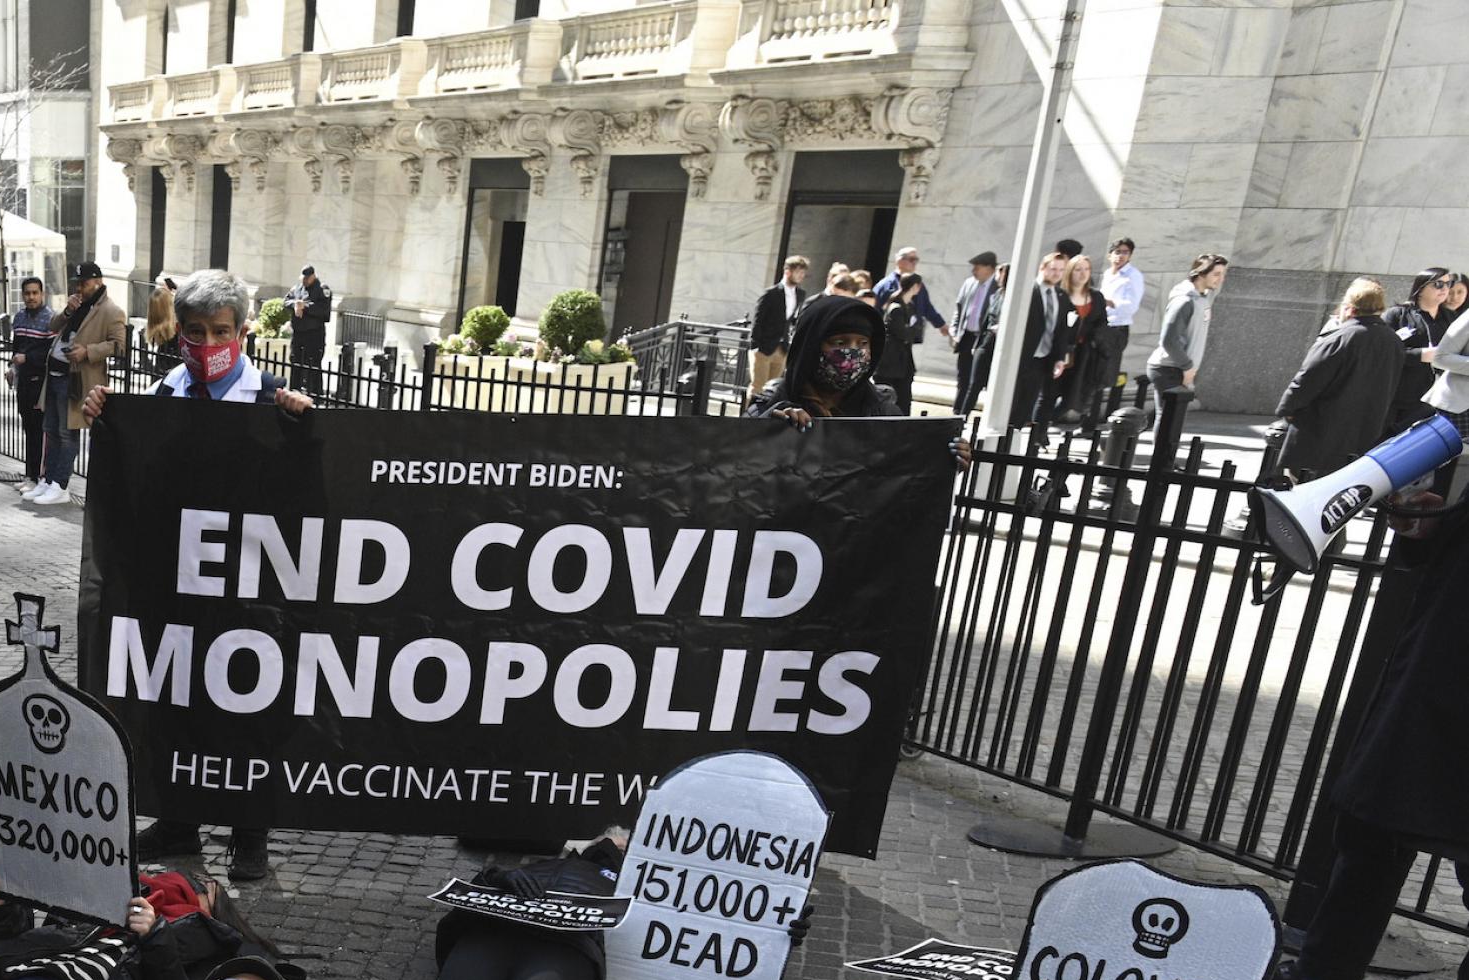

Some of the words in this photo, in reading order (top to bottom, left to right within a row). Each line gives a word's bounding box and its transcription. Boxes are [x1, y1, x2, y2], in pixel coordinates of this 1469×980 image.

[371, 460, 523, 486] PRESIDENT
[529, 464, 624, 489] BIDEN:
[1323, 500, 1345, 526] ACT
[1341, 487, 1362, 509] UP
[176, 508, 410, 604] END
[451, 522, 823, 618] COVID
[106, 615, 880, 735] MONOPOLIES
[171, 751, 269, 791] HELP
[282, 760, 512, 803] VACCINATE
[524, 770, 605, 805] THE
[617, 773, 658, 805] W
[643, 813, 814, 879] INDONESIA
[446, 892, 617, 924] MONOPOLIES
[467, 891, 517, 904] END
[525, 899, 604, 916] COVID
[633, 860, 796, 925] 151,000+
[477, 904, 534, 919] VACCINATE
[539, 916, 559, 925] THE
[561, 920, 603, 928] WORLD
[641, 920, 758, 978] DEAD
[919, 953, 975, 963] END
